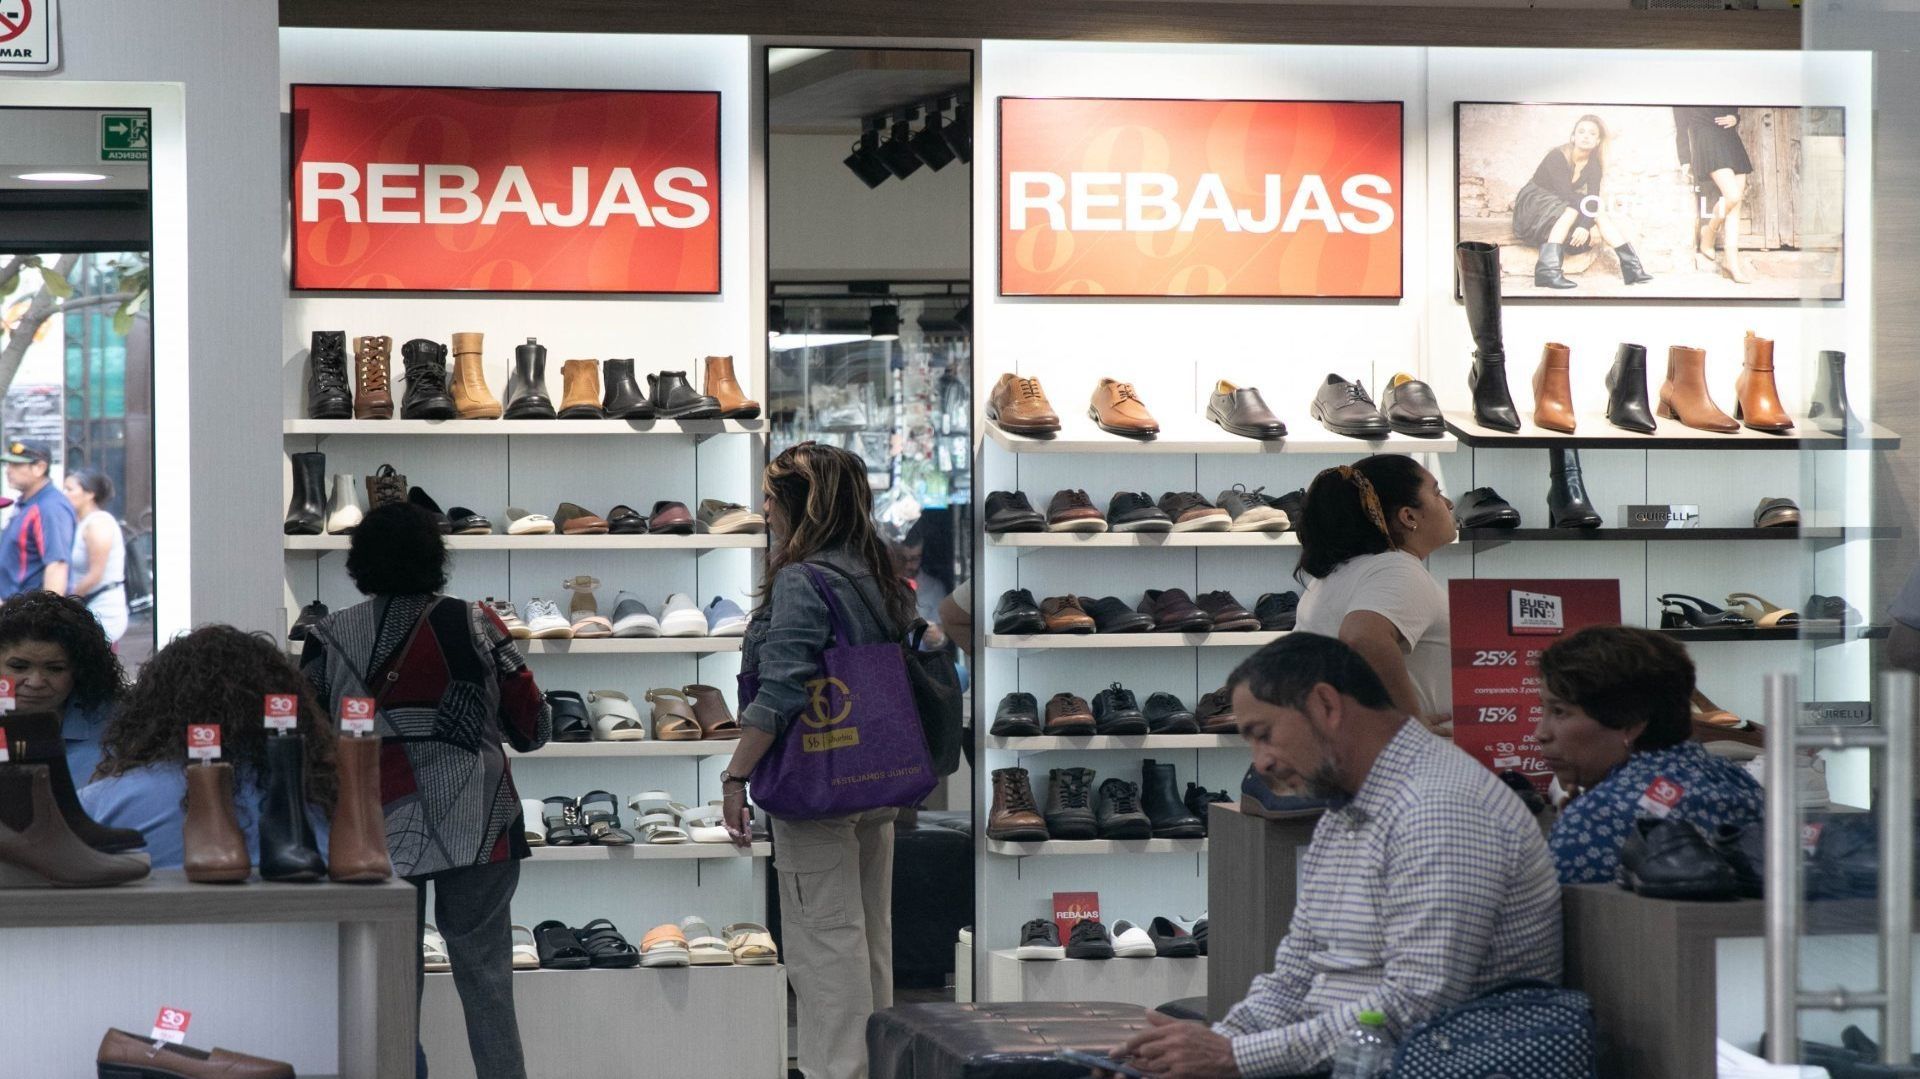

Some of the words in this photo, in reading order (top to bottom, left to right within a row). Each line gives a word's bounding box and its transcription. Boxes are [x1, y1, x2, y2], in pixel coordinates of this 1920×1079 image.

[301, 161, 711, 230] REBAJAS
[1009, 172, 1394, 234] REBAJAS
[1519, 597, 1555, 610] BUEN
[1472, 650, 1518, 666] 25%
[1474, 687, 1519, 695] comprando
[270, 697, 293, 712] 30
[346, 700, 370, 714] 30
[1478, 706, 1517, 723] 15%
[192, 727, 215, 740] 30
[1056, 910, 1099, 919] REBAJAS
[161, 1009, 185, 1027] 30
